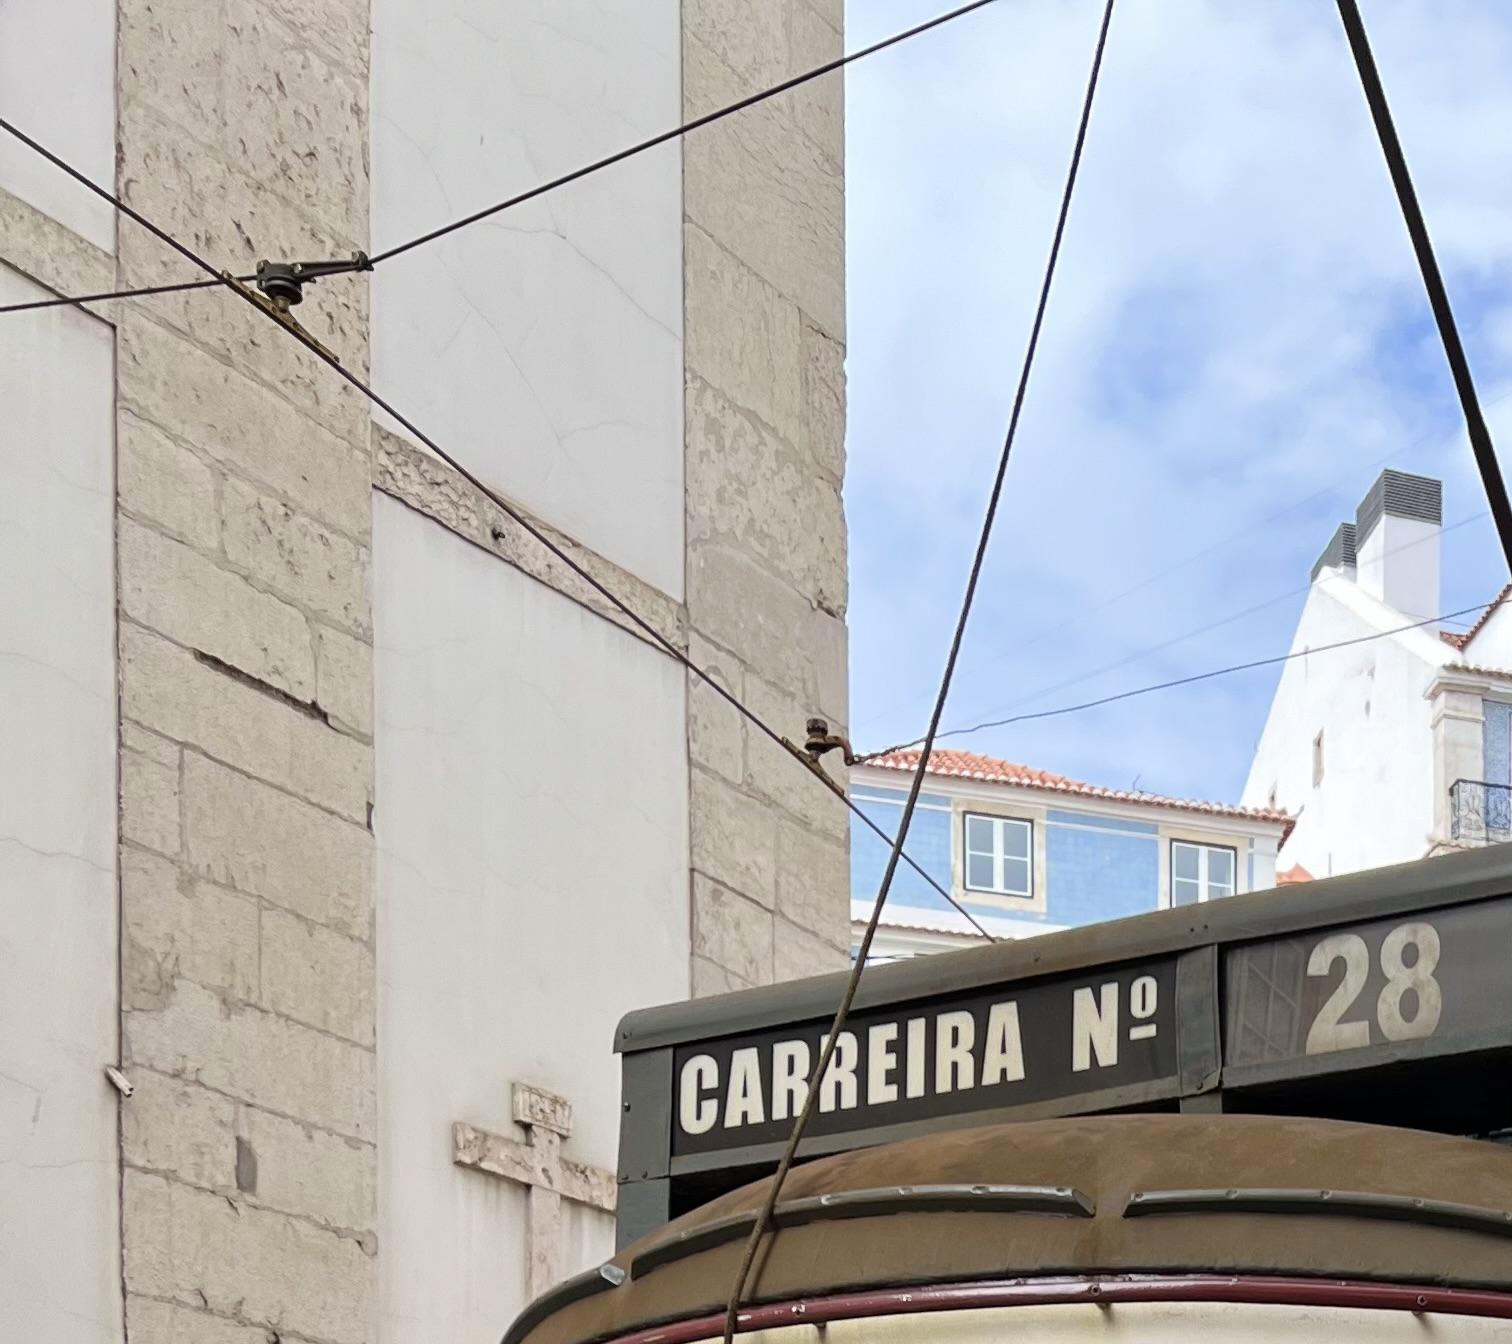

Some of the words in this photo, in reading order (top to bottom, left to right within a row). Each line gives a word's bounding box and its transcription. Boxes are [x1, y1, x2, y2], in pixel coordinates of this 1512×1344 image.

[679, 1001, 1026, 1136] CARREIRA
[1072, 975, 1159, 1073] Nº
[1305, 922, 1443, 1054] 28
